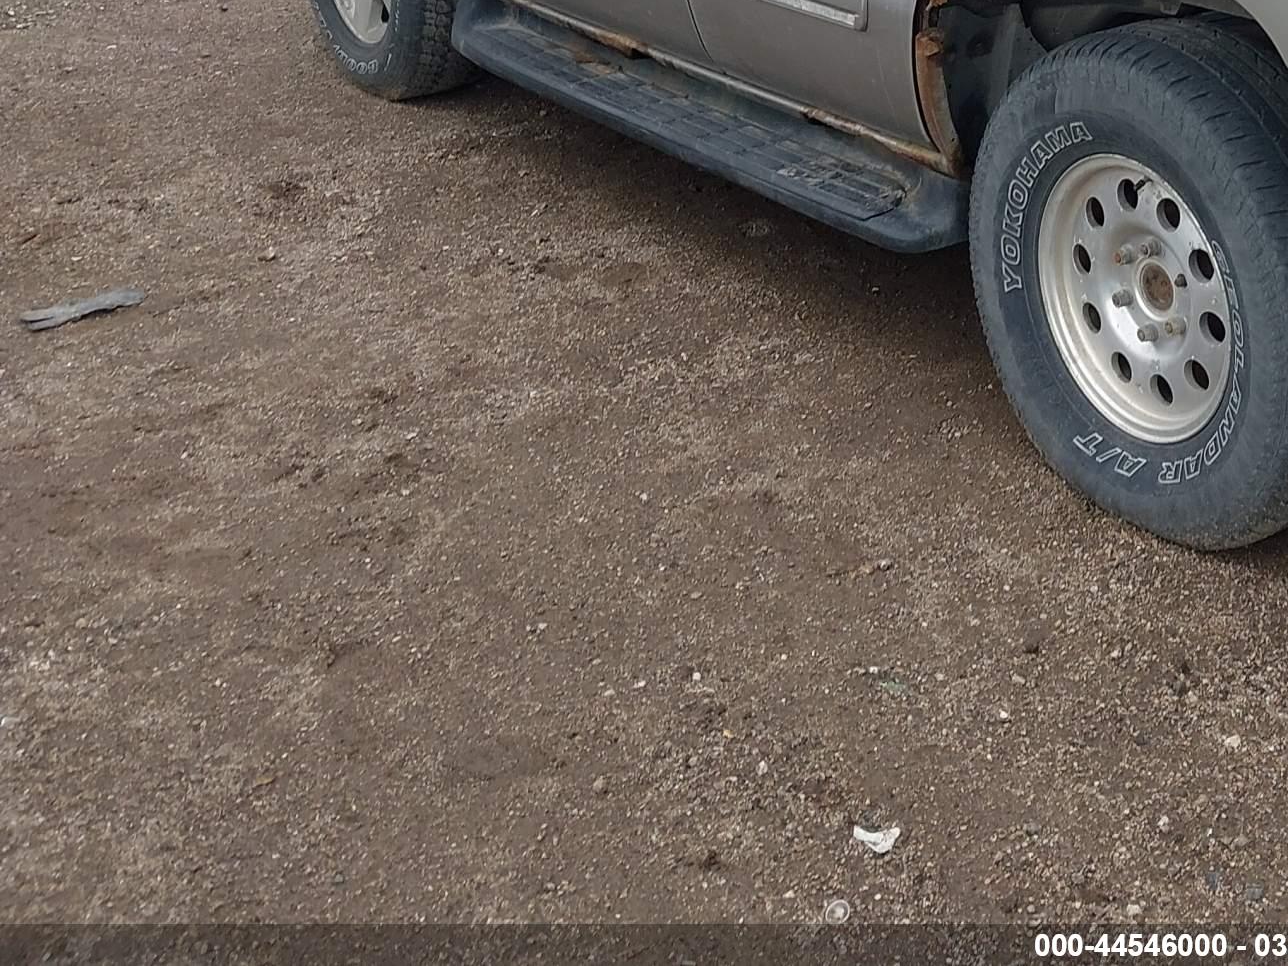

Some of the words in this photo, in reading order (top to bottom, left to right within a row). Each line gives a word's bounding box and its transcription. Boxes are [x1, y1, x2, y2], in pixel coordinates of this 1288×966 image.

[1000, 121, 1094, 293] YOKOHAMA
[1158, 239, 1245, 484] GEOLANDAR
[1072, 431, 1147, 478] A/T
